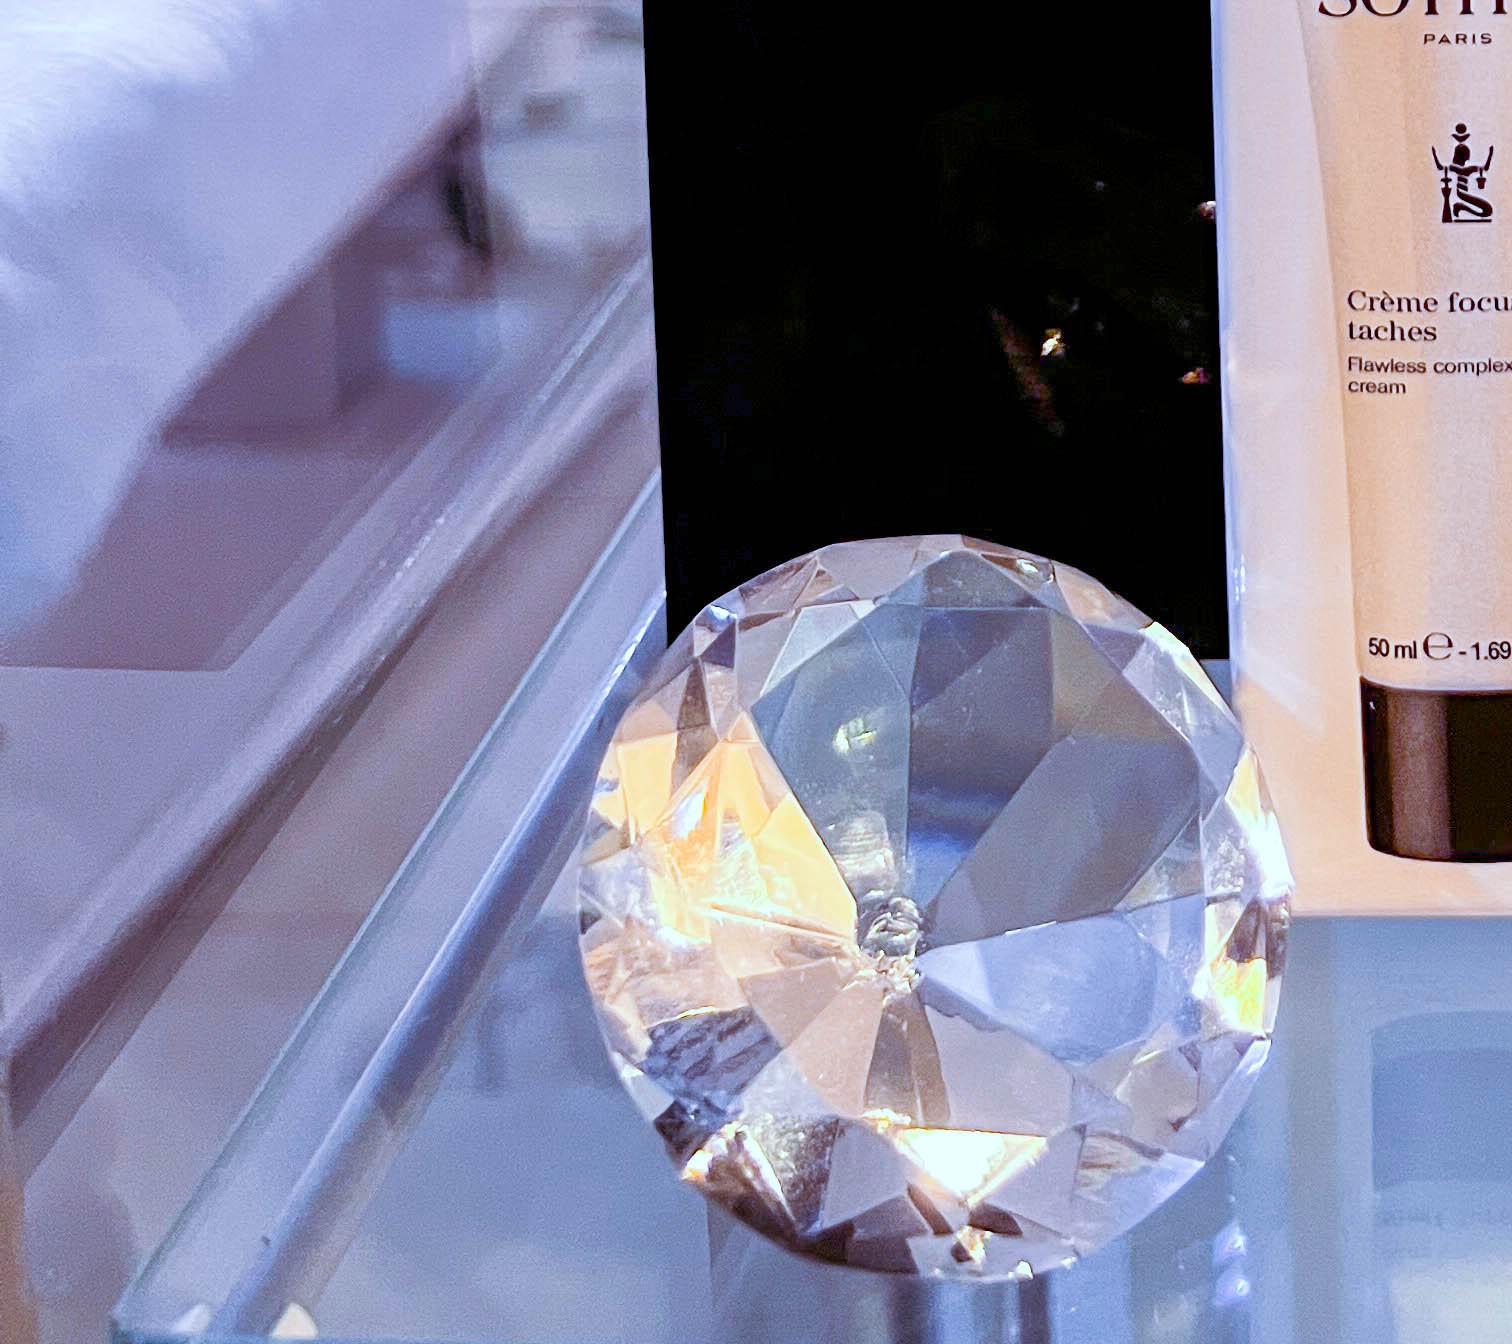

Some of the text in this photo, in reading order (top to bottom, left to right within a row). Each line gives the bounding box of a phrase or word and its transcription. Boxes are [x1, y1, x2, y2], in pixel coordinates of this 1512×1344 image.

[1424, 33, 1493, 45] PARIS
[1347, 290, 1438, 312] Crème
[1348, 321, 1437, 343] taches
[1348, 357, 1427, 374] Flawless
[1348, 378, 1406, 394] cream
[1369, 637, 1389, 657] 50
[1394, 640, 1417, 659] ml
[1471, 642, 1511, 660] 1.69
